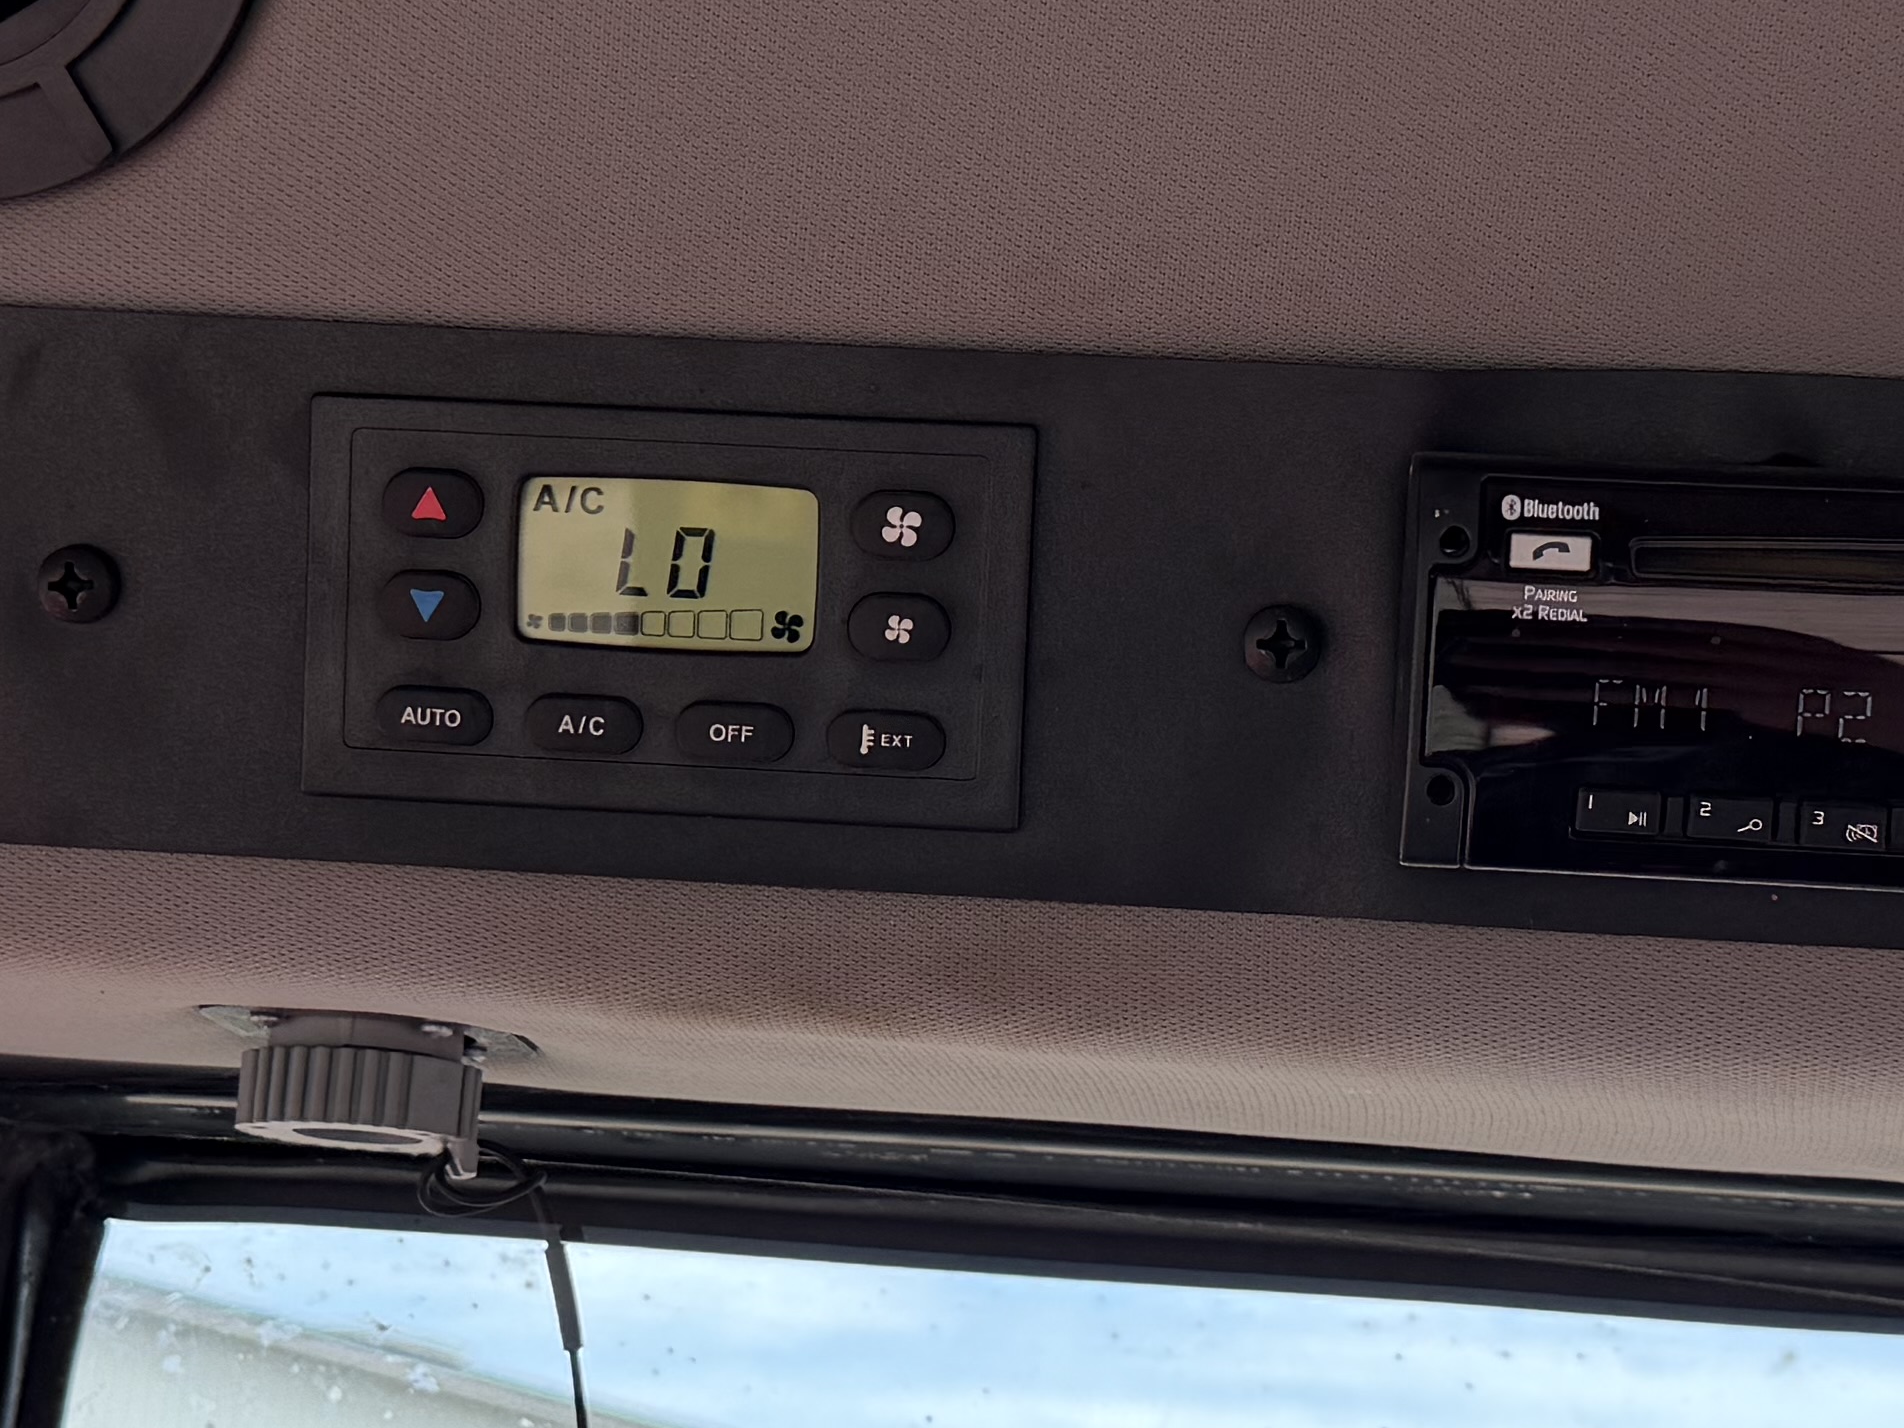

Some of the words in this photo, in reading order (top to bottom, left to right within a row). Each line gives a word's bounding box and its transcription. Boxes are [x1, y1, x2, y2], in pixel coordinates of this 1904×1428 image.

[533, 484, 605, 515] A/C
[1523, 498, 1599, 521] Bluetooth
[401, 706, 462, 730] AUTO
[557, 713, 606, 737] A/C
[1797, 688, 1872, 744] P2
[708, 723, 754, 745] OFF
[880, 732, 913, 748] EXT
[1588, 794, 1594, 810] 1
[1699, 801, 1712, 817] 2
[1812, 810, 1825, 825] 3
